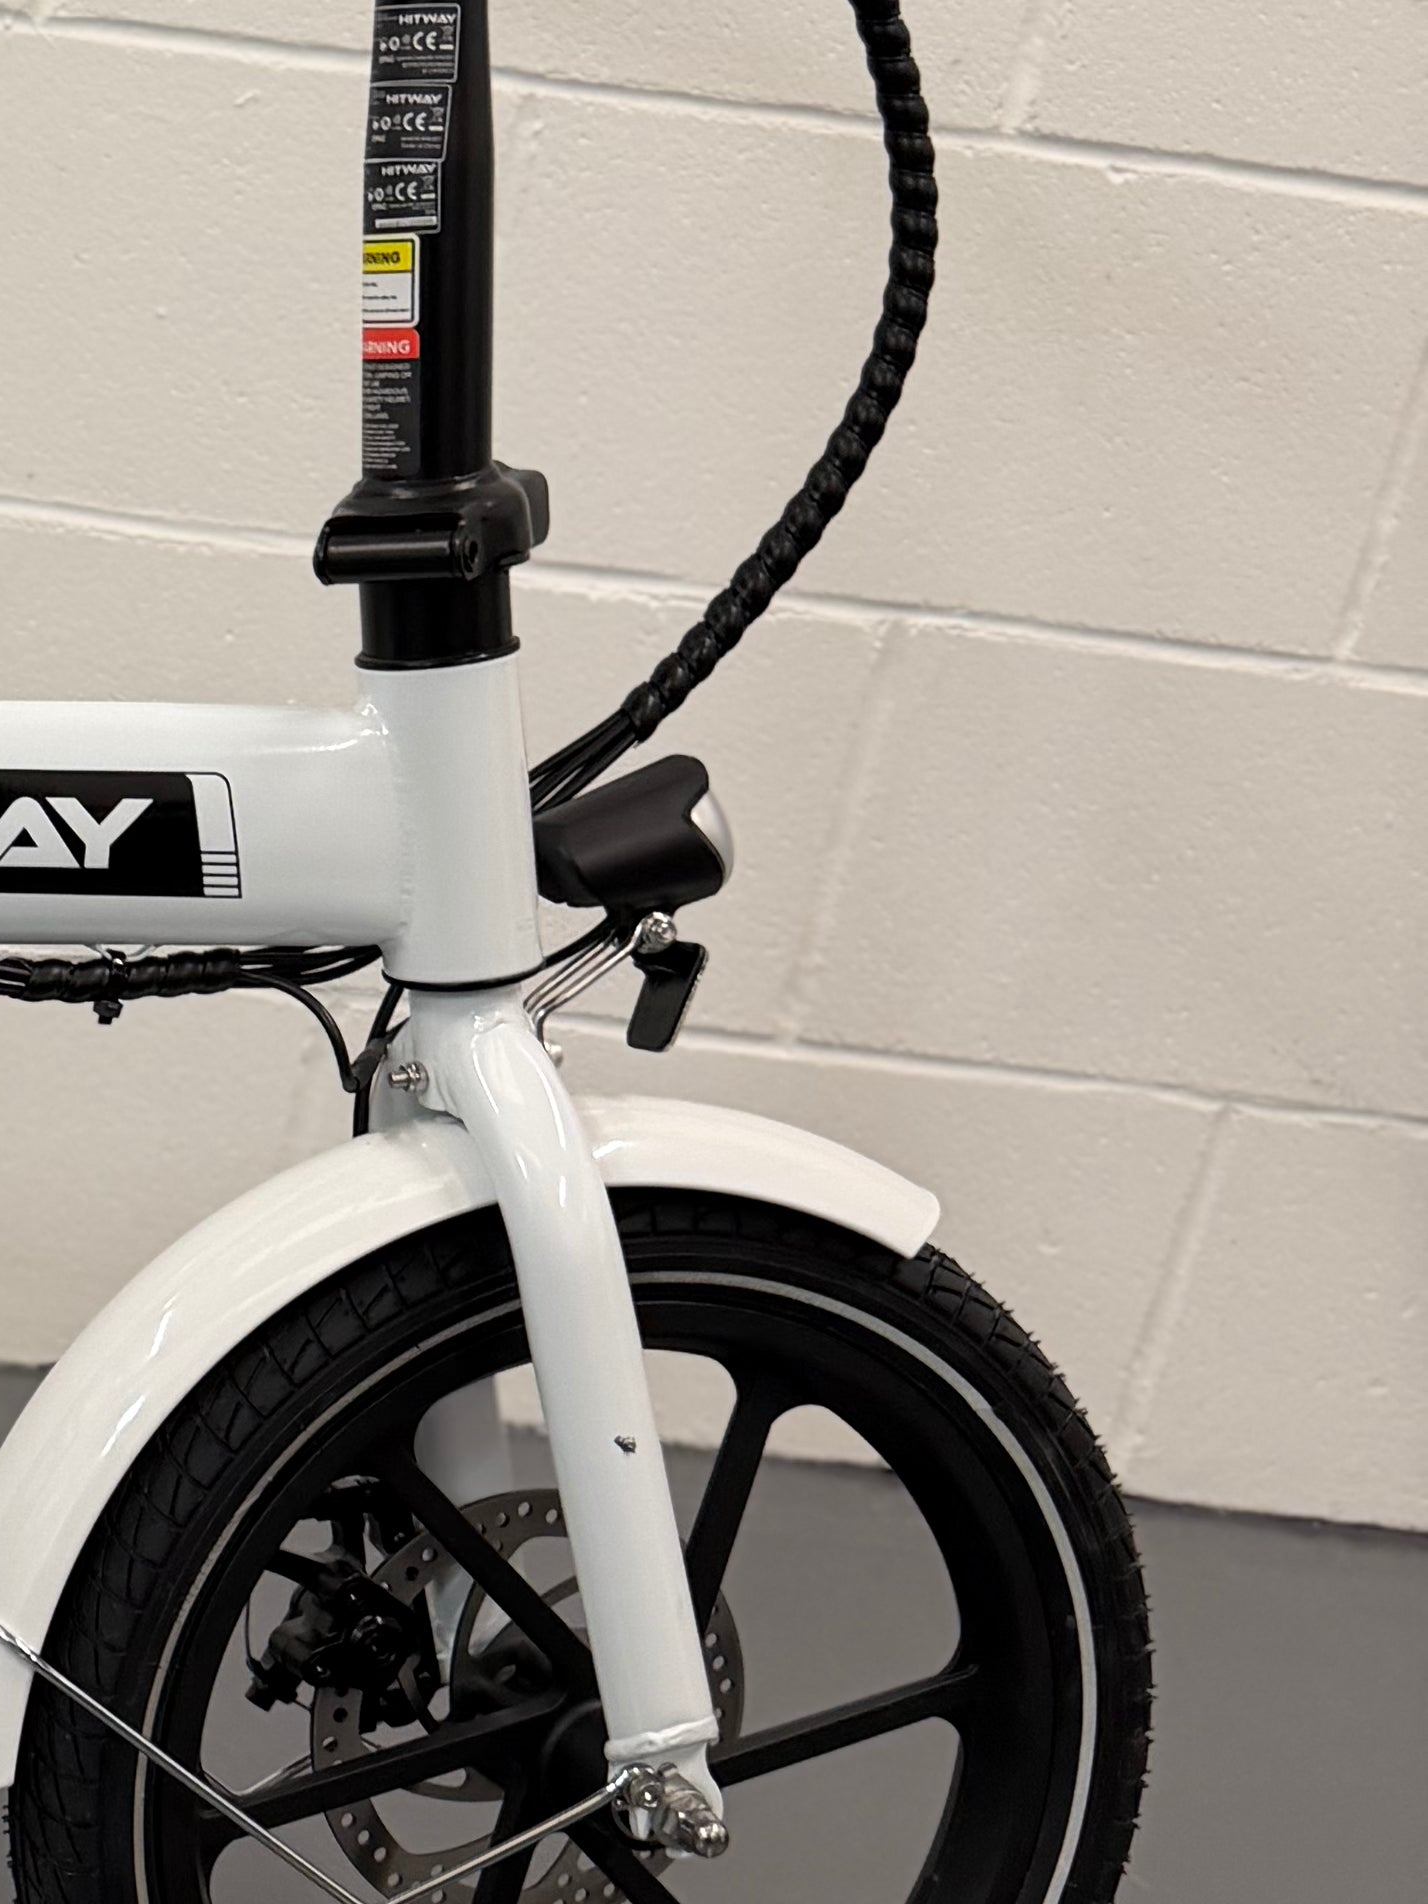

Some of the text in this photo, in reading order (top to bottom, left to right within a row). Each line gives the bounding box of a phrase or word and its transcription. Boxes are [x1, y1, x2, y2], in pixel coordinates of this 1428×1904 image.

[398, 13, 456, 25] HITWAY
[386, 93, 442, 105] HITWAY
[381, 163, 437, 176] HITWAY
